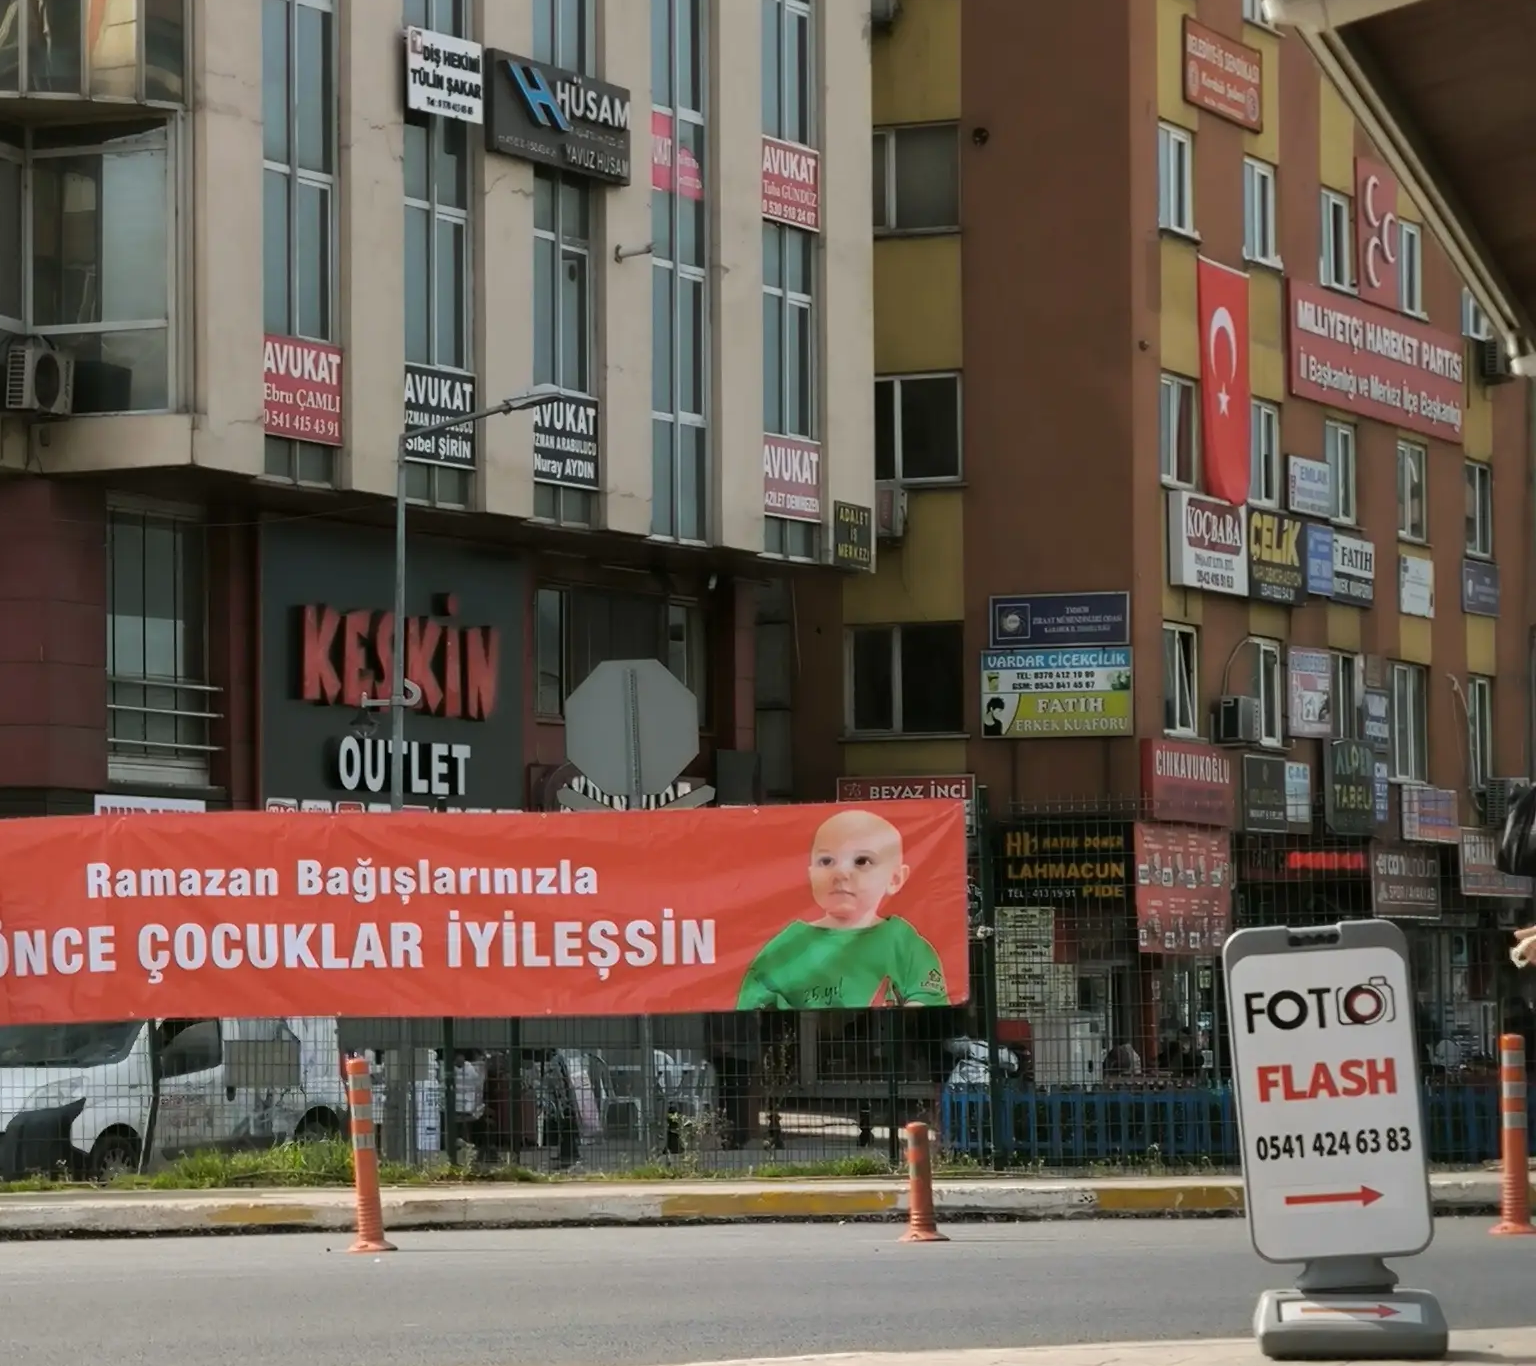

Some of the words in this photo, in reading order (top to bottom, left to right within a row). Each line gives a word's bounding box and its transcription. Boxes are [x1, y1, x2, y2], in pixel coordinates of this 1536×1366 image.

[556, 76, 631, 129] HÜSAM
[763, 146, 816, 185] AVUKAT
[1297, 298, 1363, 355] MİLLİYETÇİ
[1365, 323, 1419, 366] HAREKET
[1421, 339, 1463, 383] PARTİSİ
[264, 340, 341, 387] AVUKAT
[264, 382, 293, 407] Ebru
[296, 387, 341, 414] ÇAMLI
[404, 373, 472, 412] AVUKAT
[271, 412, 290, 428] 541
[293, 415, 311, 431] 415
[312, 419, 326, 435] 43
[327, 421, 339, 437] 91
[534, 401, 597, 436] AVUKAT
[438, 433, 471, 461] ŞİRİN
[535, 452, 563, 479] Nuray
[565, 458, 595, 481] AYDIN
[764, 445, 819, 485] AVUKAT
[839, 507, 869, 525] ADALET
[1186, 505, 1242, 547] KOÇBABA
[1249, 510, 1301, 567] ÇELİK
[1341, 540, 1373, 573] FATİH
[303, 592, 501, 720] KESKİN
[988, 654, 1044, 669] VARDAR
[1048, 650, 1126, 669] ÇİÇEKÇİLİK
[1037, 695, 1105, 713] FATİH
[1016, 719, 1060, 731] ERKEK
[870, 785, 924, 799] BEYAZ
[930, 780, 967, 799] İNCİ
[86, 861, 279, 898] Ramazan
[297, 857, 599, 907] Bağışlarınızla
[1008, 862, 1125, 880] LAHMACUN
[1082, 879, 1124, 897] PİDE
[137, 922, 425, 984] ÇOCUKLAR
[446, 907, 717, 981] İYİLEŞSİN
[1244, 980, 1390, 1034] FOTO
[1256, 1056, 1398, 1103] FLASH
[1255, 1133, 1305, 1161] 0541
[1311, 1129, 1350, 1157] 424
[1355, 1128, 1382, 1154] 63
[1386, 1126, 1412, 1152] 83
